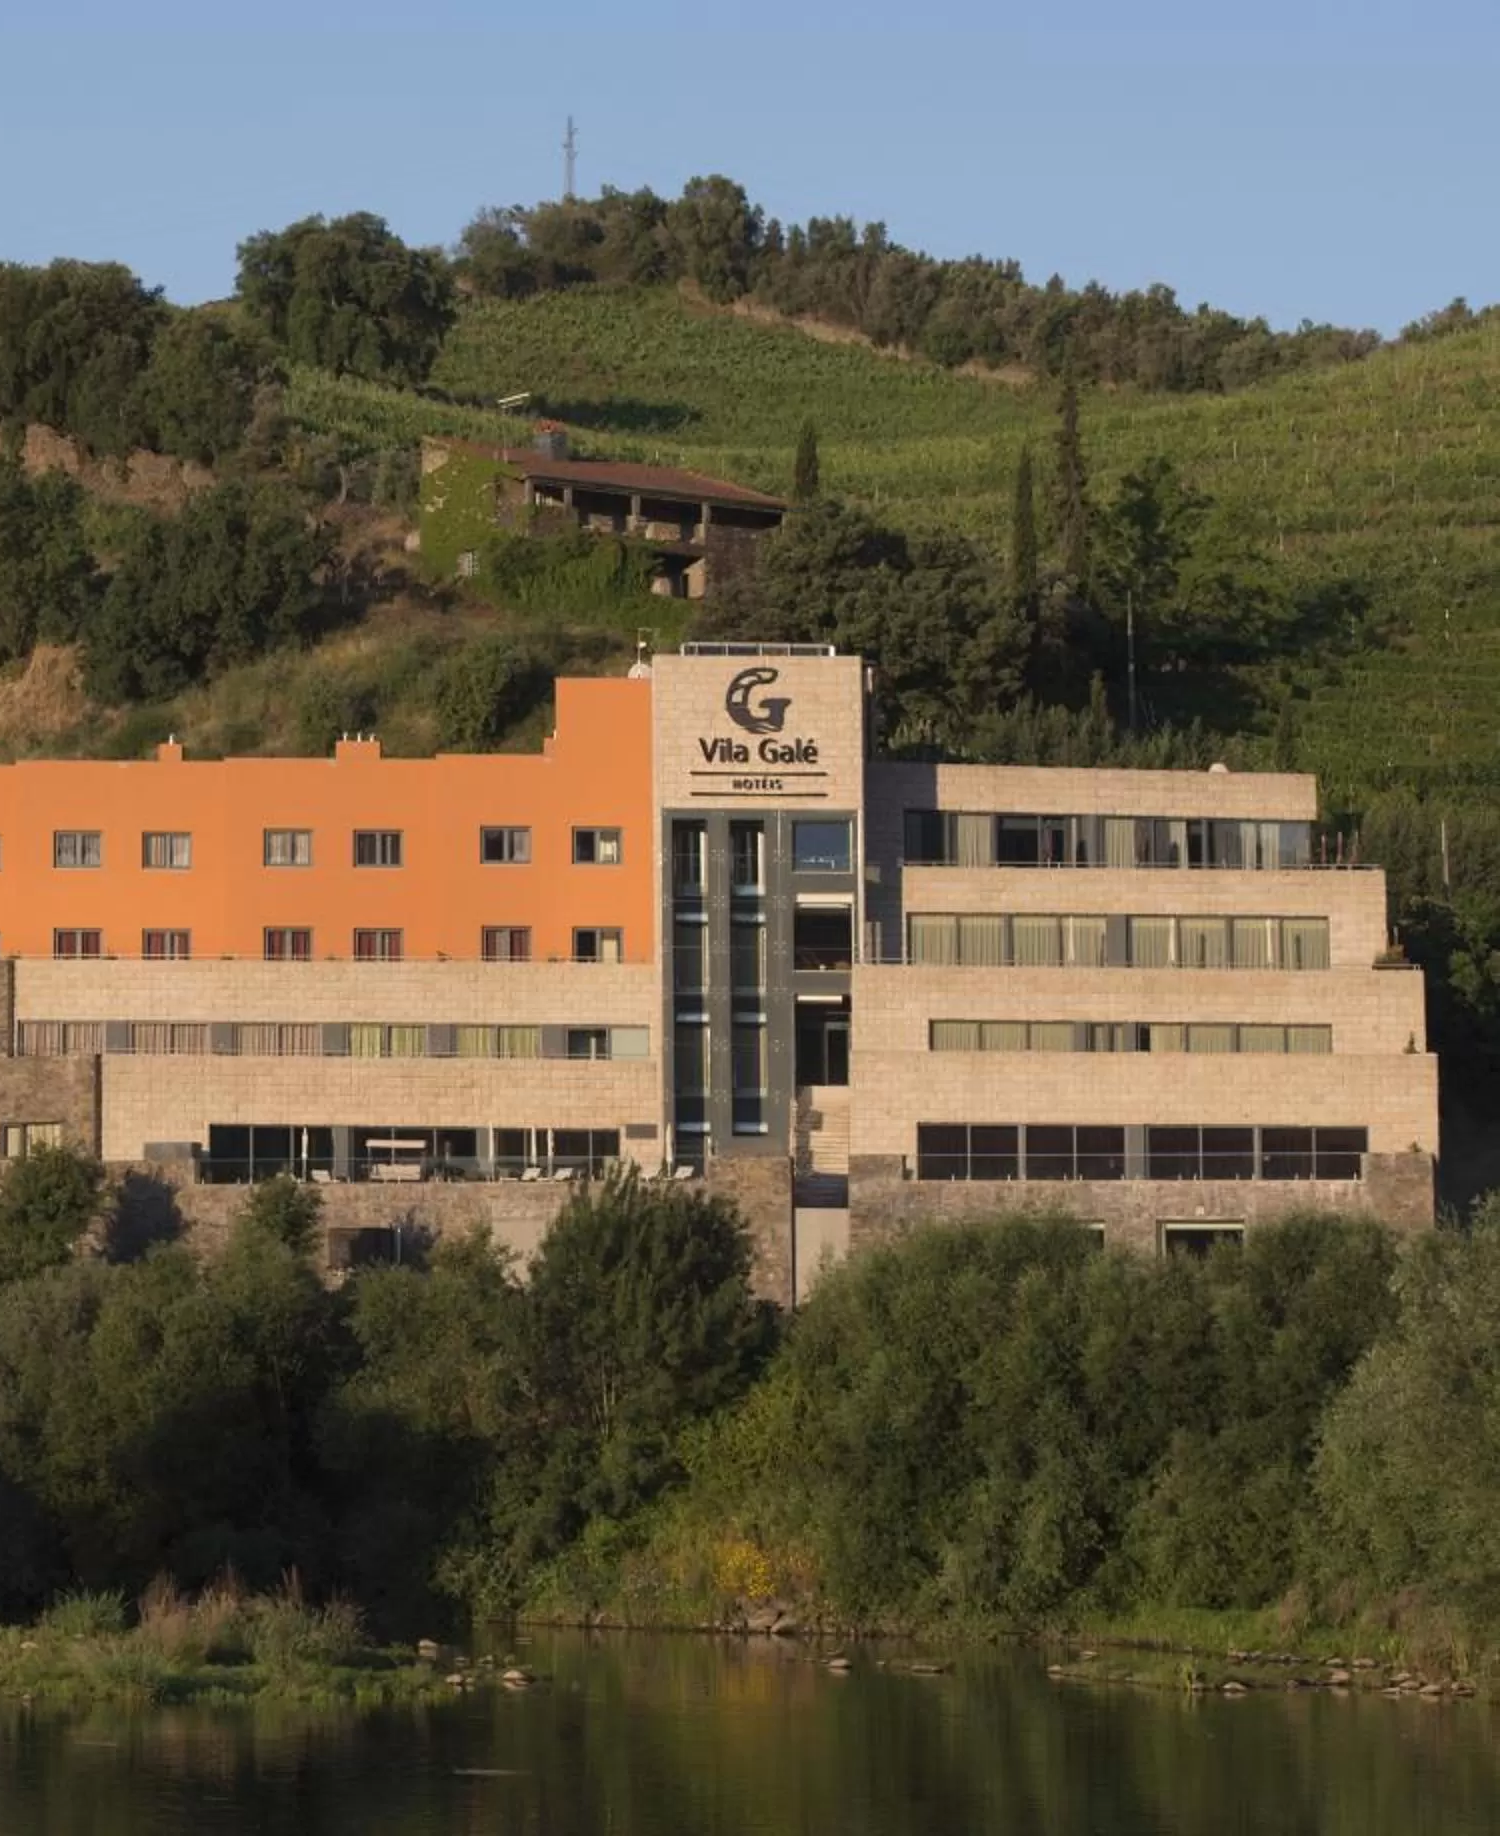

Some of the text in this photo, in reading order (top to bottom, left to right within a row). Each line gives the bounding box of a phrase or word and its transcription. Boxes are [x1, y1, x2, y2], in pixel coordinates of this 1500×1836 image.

[726, 667, 792, 734] G
[699, 737, 819, 764] Vila Galé
